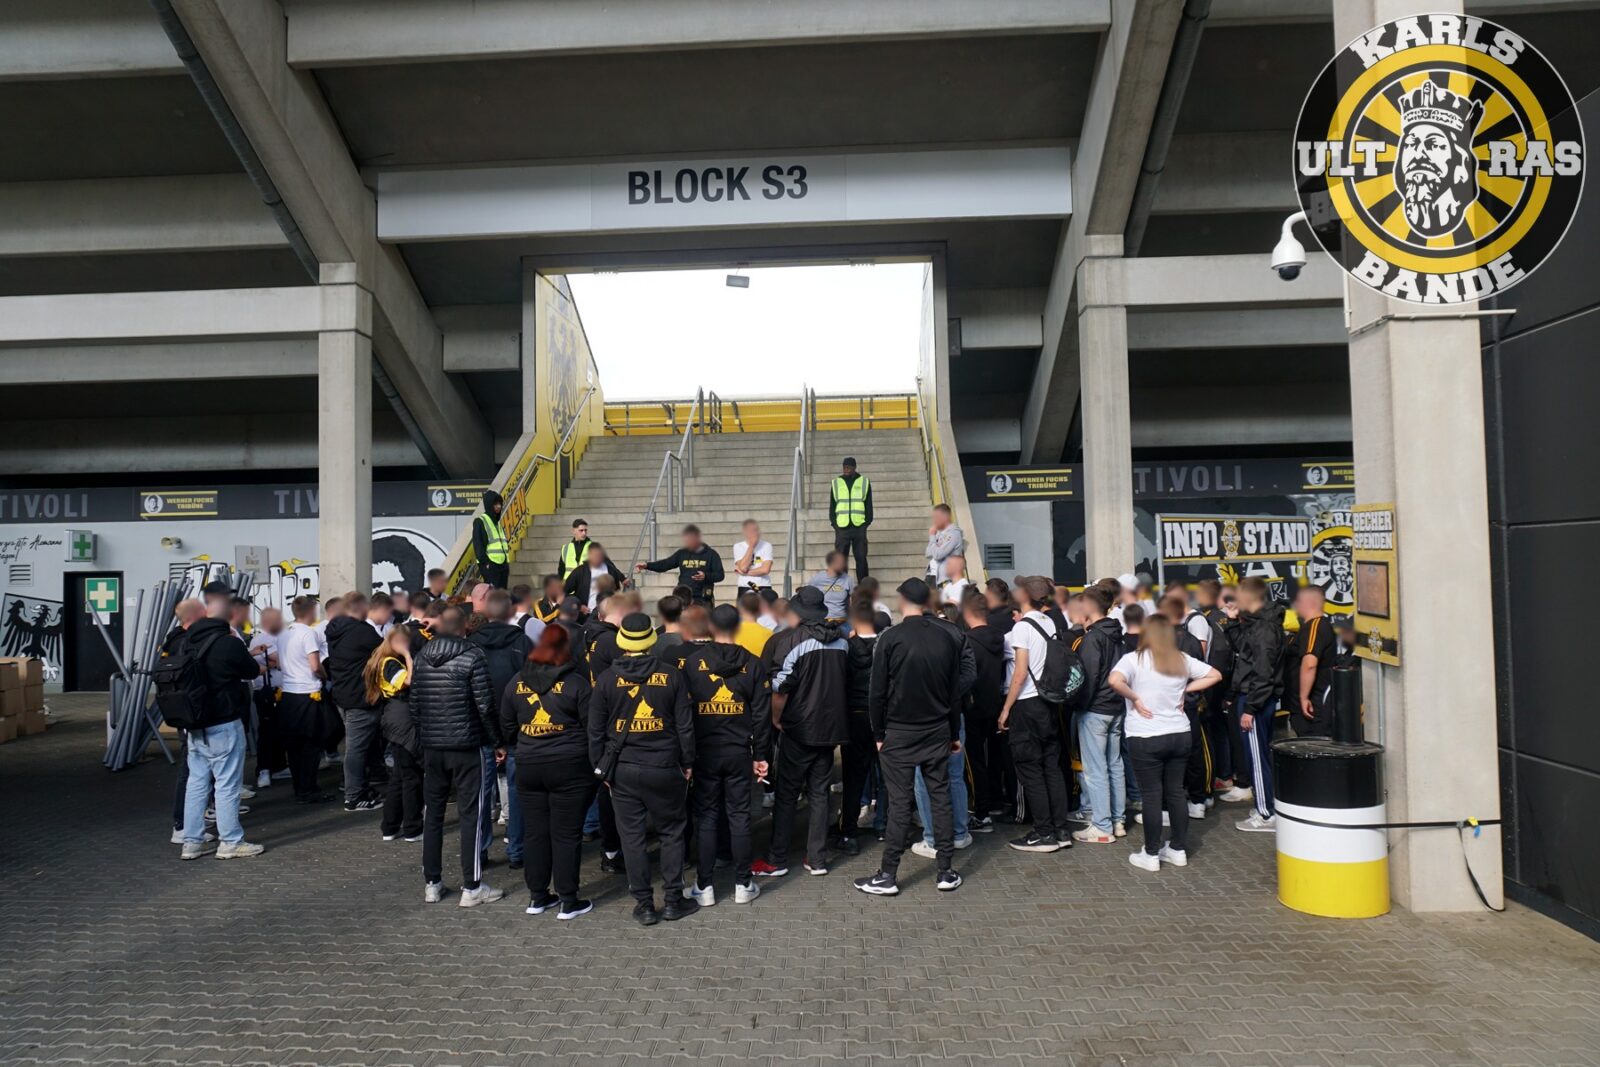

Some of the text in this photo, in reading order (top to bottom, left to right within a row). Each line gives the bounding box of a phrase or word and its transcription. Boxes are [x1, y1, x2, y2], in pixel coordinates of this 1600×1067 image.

[628, 165, 809, 205] BLOCK S3
[1133, 465, 1243, 492] TIVOLI
[273, 489, 319, 514] TIV
[1353, 511, 1393, 531] BECHER
[1164, 521, 1309, 558] INFO STAND
[1354, 532, 1393, 550] SPENDEN
[699, 701, 744, 715] FANATICS
